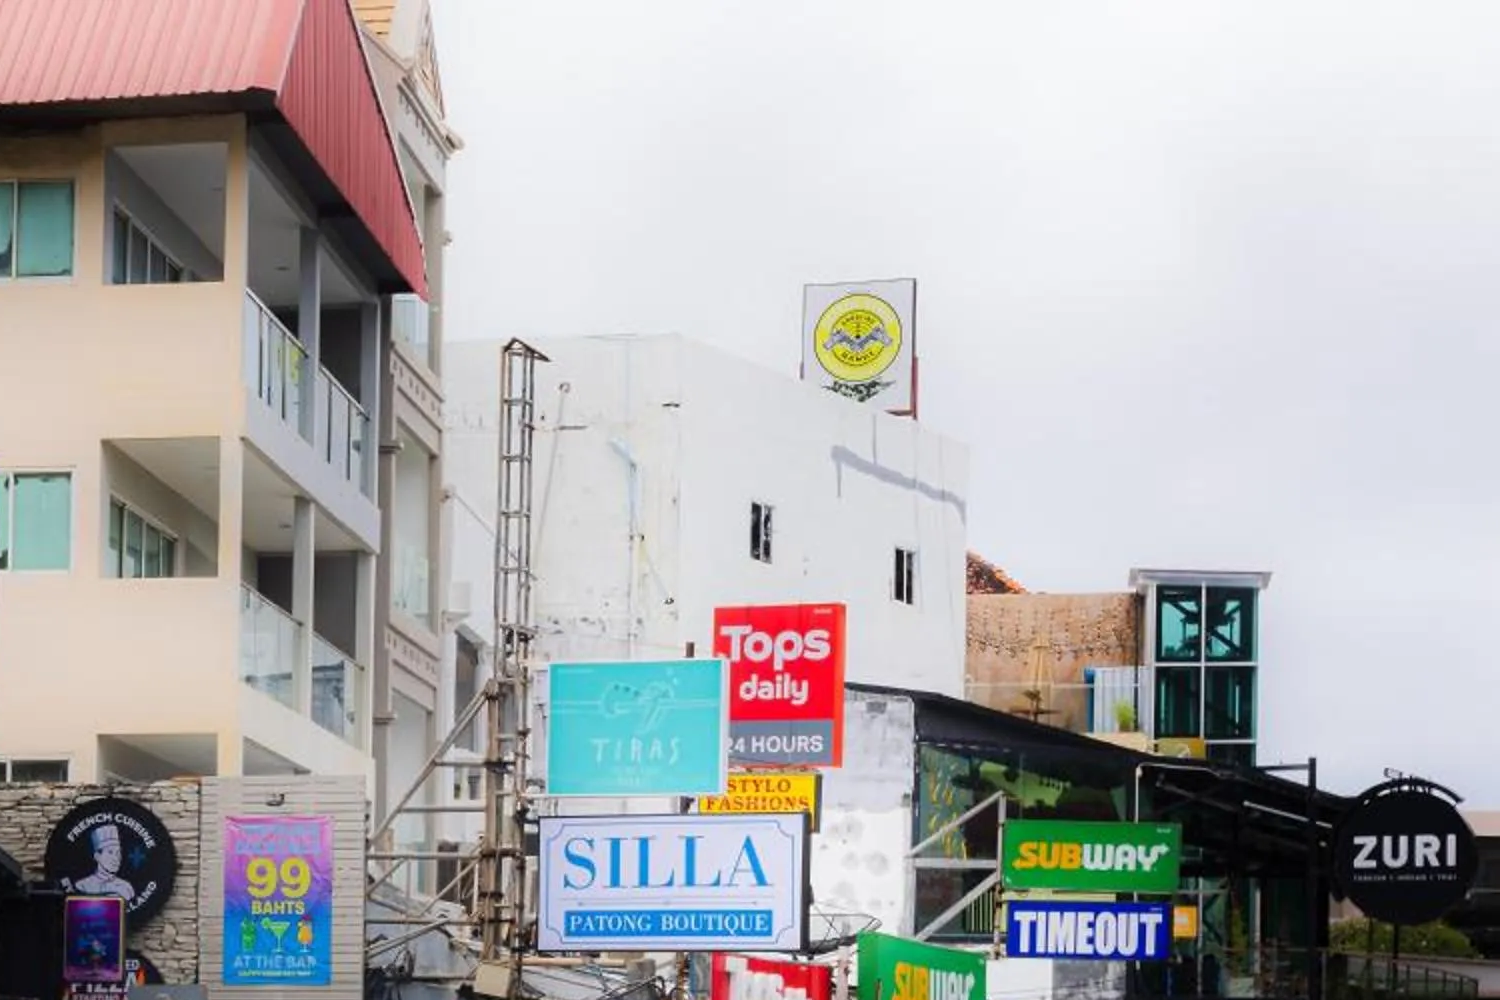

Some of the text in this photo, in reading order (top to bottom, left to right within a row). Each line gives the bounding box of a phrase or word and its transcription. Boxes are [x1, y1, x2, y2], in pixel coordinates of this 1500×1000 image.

[719, 624, 831, 672] Tops
[739, 673, 809, 706] daily
[590, 737, 680, 766] TIRAS
[751, 734, 824, 754] HOURS
[726, 778, 792, 794] STYLO
[705, 796, 810, 812] FASHIONS
[66, 811, 112, 842] FRENCH
[114, 812, 157, 850] CUISINE
[563, 834, 774, 891] SILLA
[1011, 840, 1170, 873] SUBWAY
[1352, 833, 1457, 869] ZURI
[246, 857, 312, 898] 99
[251, 900, 306, 915] BAHTS
[569, 913, 770, 937] PATONG BOUTIQUE
[1013, 911, 1164, 956] TIMEOUT
[233, 954, 252, 969] AT
[255, 954, 284, 969] THE
